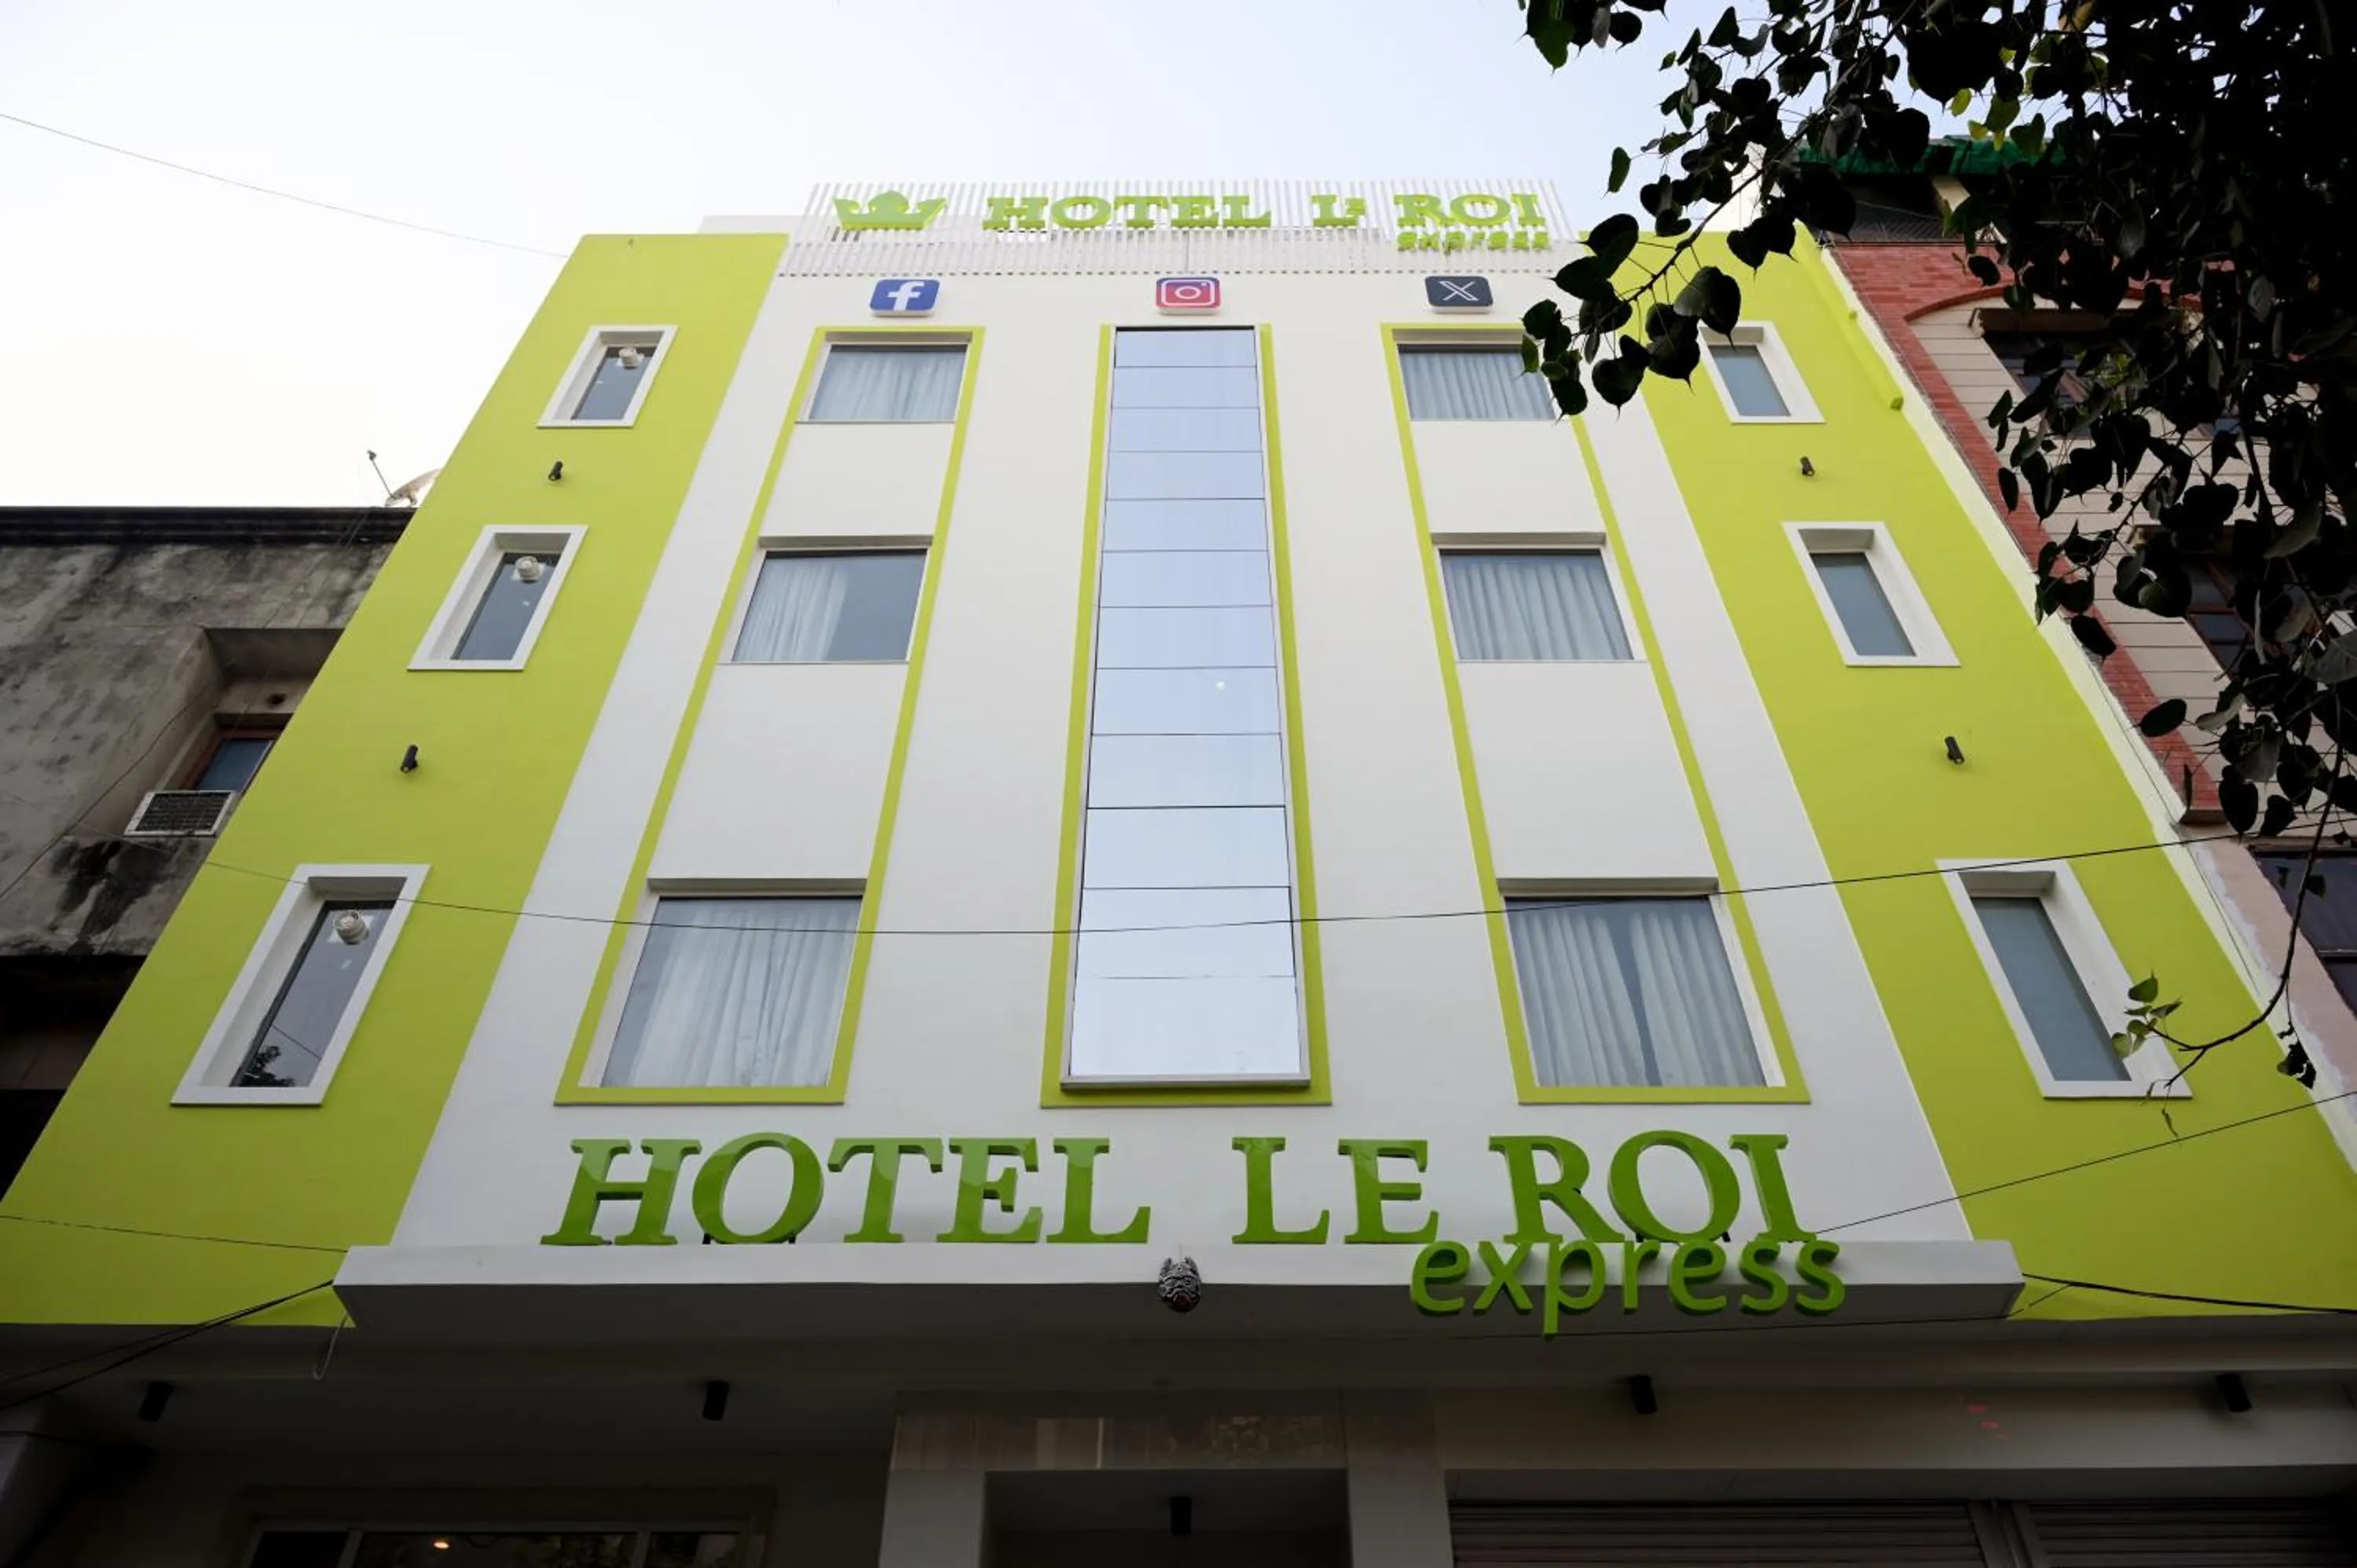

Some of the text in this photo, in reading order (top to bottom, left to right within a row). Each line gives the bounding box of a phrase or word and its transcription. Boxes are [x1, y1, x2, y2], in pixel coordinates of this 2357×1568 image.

[983, 195, 1271, 228] HOTEL
[1394, 193, 1546, 228] ROI
[1397, 231, 1549, 255] express
[540, 1129, 1817, 1246] HOTEL LE ROI
[1410, 1239, 1846, 1340] express
